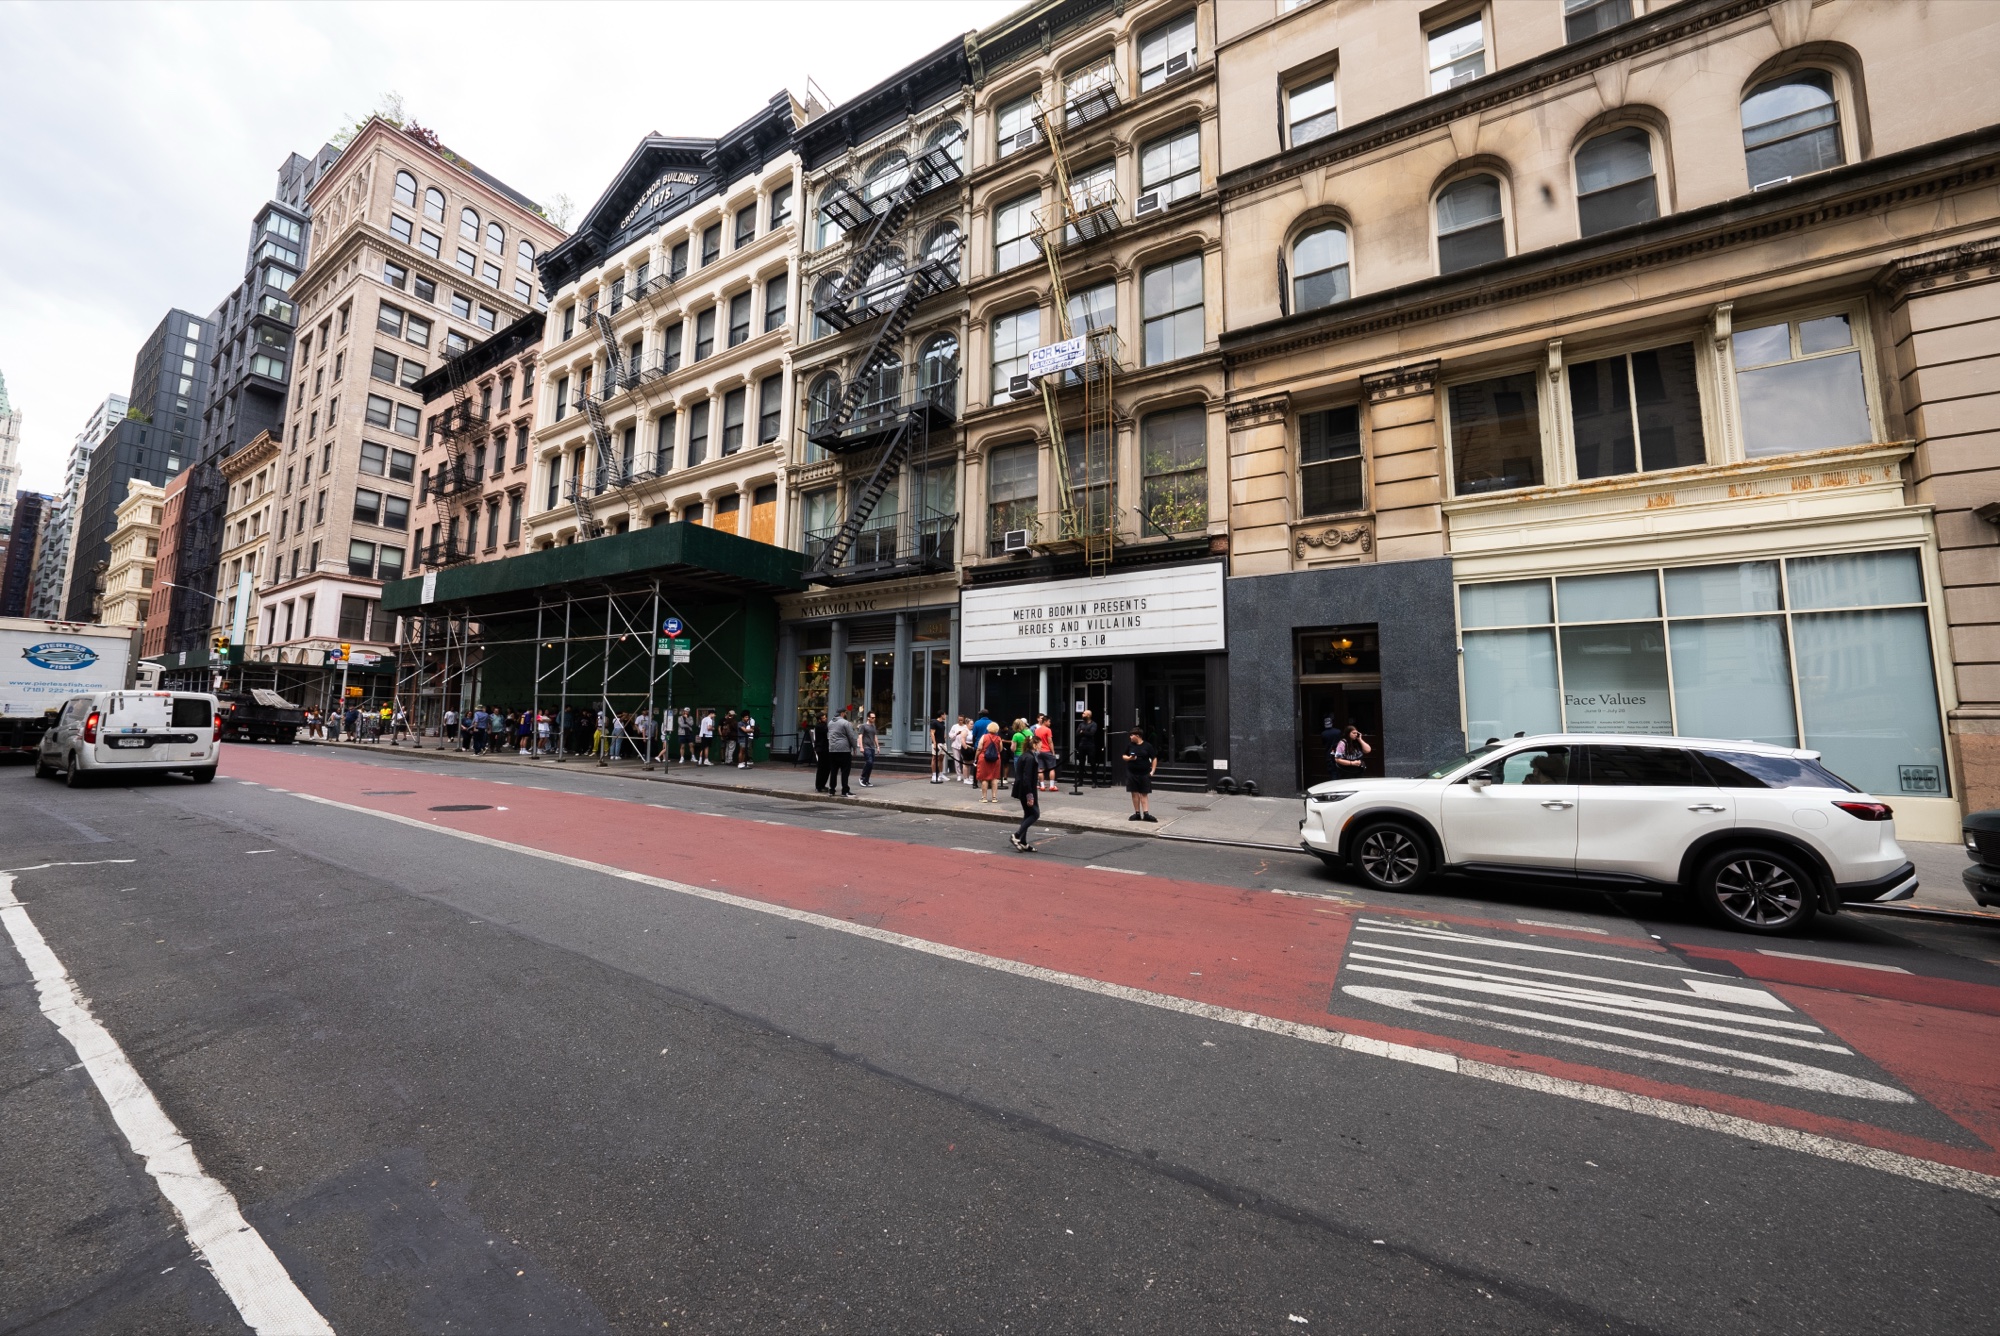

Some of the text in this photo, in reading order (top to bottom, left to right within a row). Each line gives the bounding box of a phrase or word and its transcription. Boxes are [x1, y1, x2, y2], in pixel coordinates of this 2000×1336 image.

[662, 172, 699, 185] BUILDINGS
[1033, 339, 1080, 361] FOR RENT
[854, 599, 877, 612] NYC
[1013, 598, 1147, 620] METRO BOOMIN PRESENTS
[1018, 615, 1141, 636] HEROES AND VILLAINS
[39, 643, 86, 652] PIERLESS
[1085, 668, 1108, 680] 393
[1564, 692, 1646, 706] Face Values
